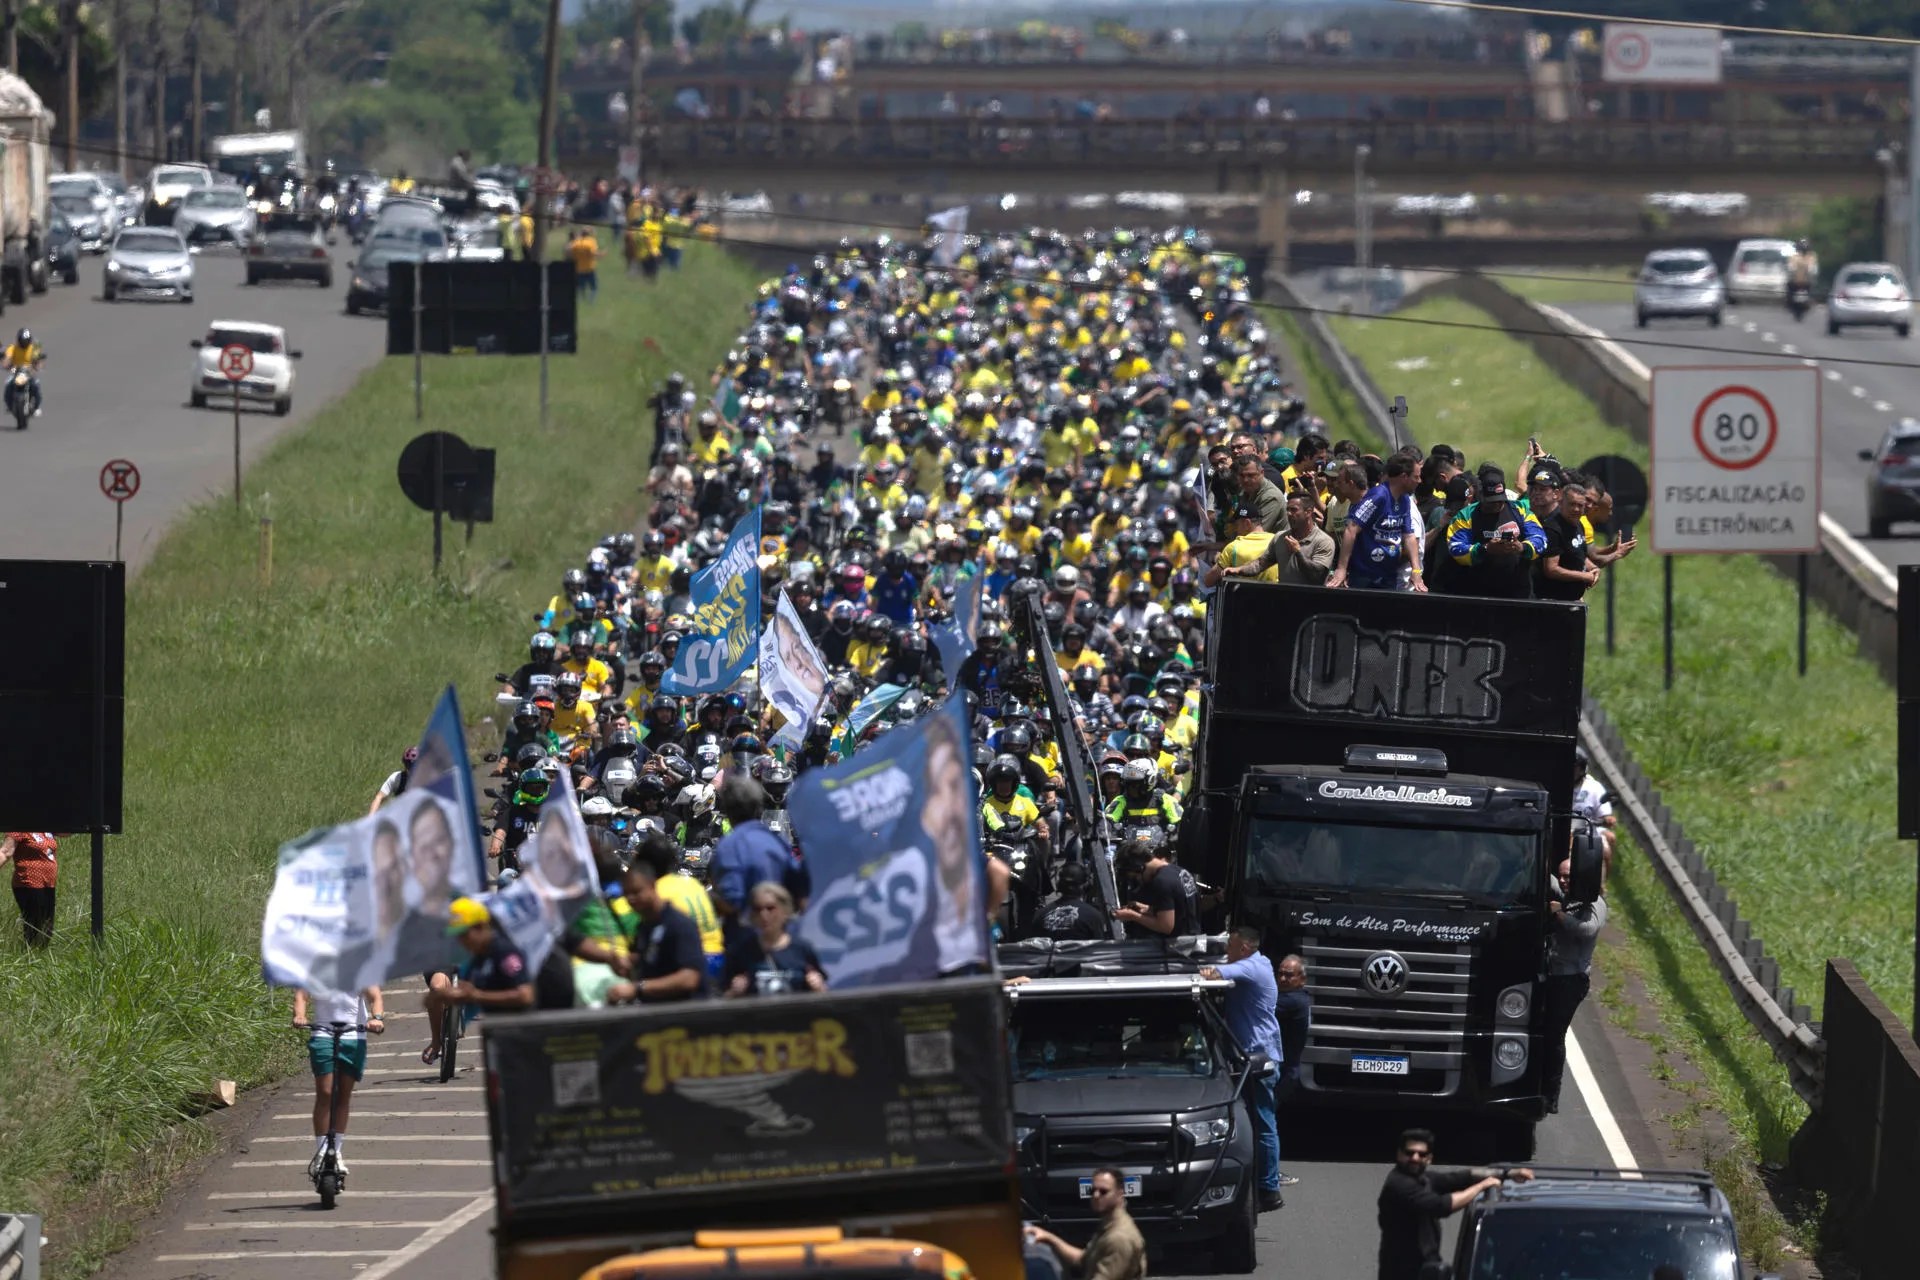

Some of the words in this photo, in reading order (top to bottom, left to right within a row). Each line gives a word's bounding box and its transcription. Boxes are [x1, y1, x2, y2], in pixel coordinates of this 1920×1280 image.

[1715, 413, 1758, 441] 80
[1665, 481, 1805, 505] FISCALIZAÇÃO
[1675, 511, 1795, 535] ELETRÔNICA
[1318, 780, 1473, 807] Constellation
[1336, 915, 1353, 928] de
[1354, 916, 1390, 932] Alta
[636, 1018, 857, 1095] TWISTER
